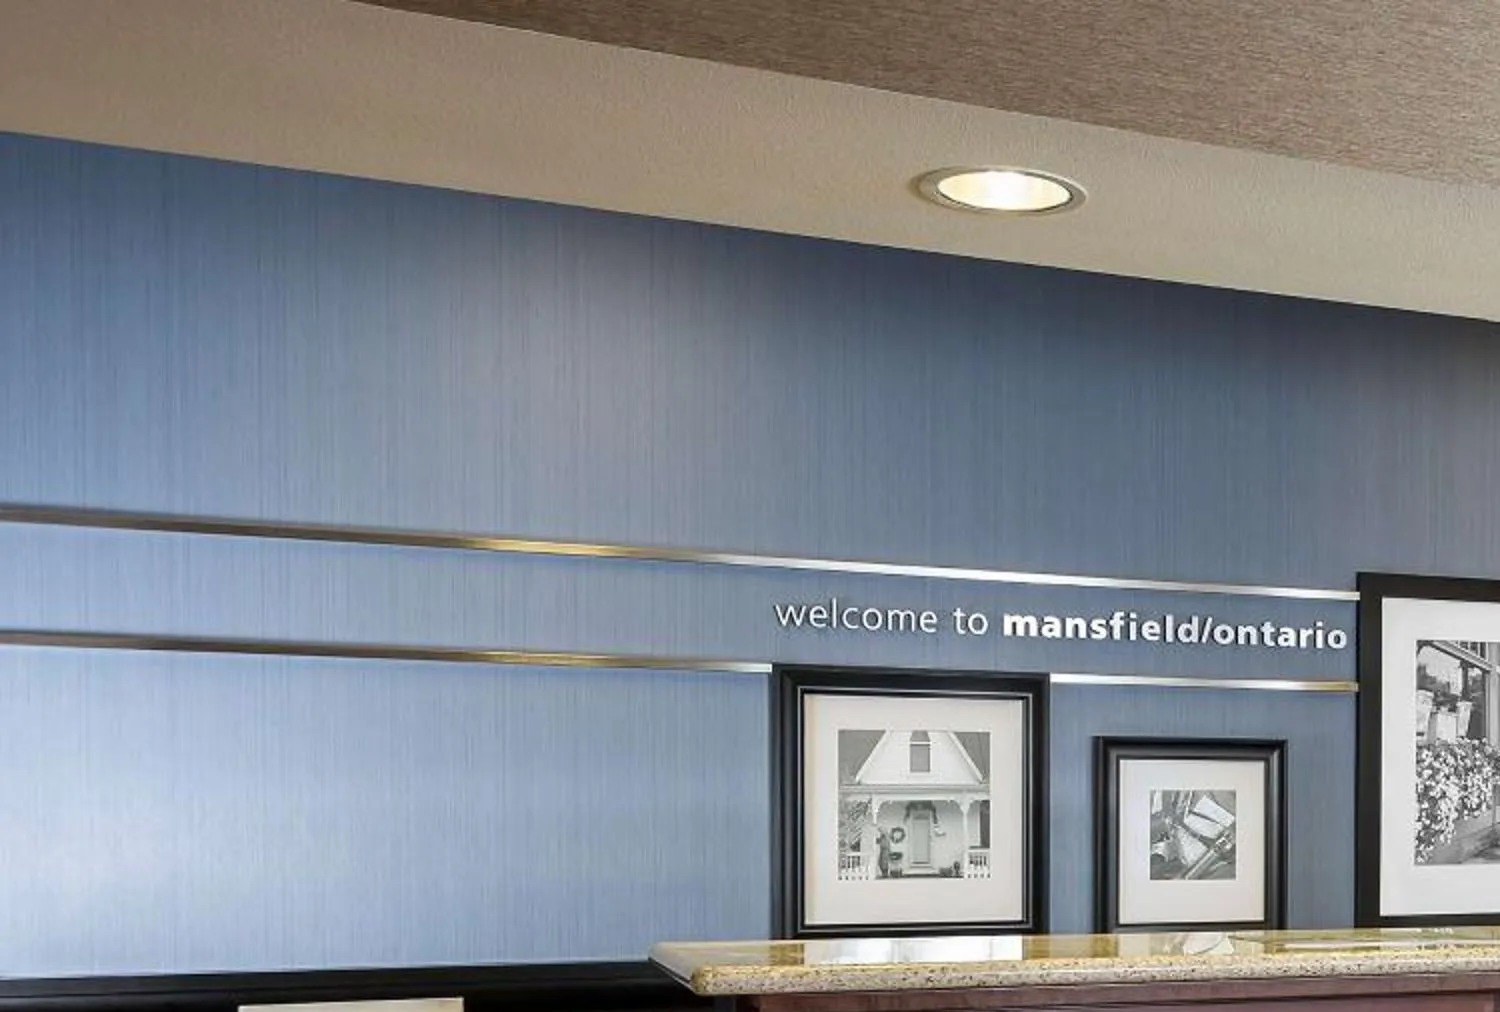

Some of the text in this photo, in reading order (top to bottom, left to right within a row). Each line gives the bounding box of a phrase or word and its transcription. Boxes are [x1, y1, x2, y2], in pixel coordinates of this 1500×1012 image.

[775, 598, 1348, 649] welcome to mansfield/ontario
